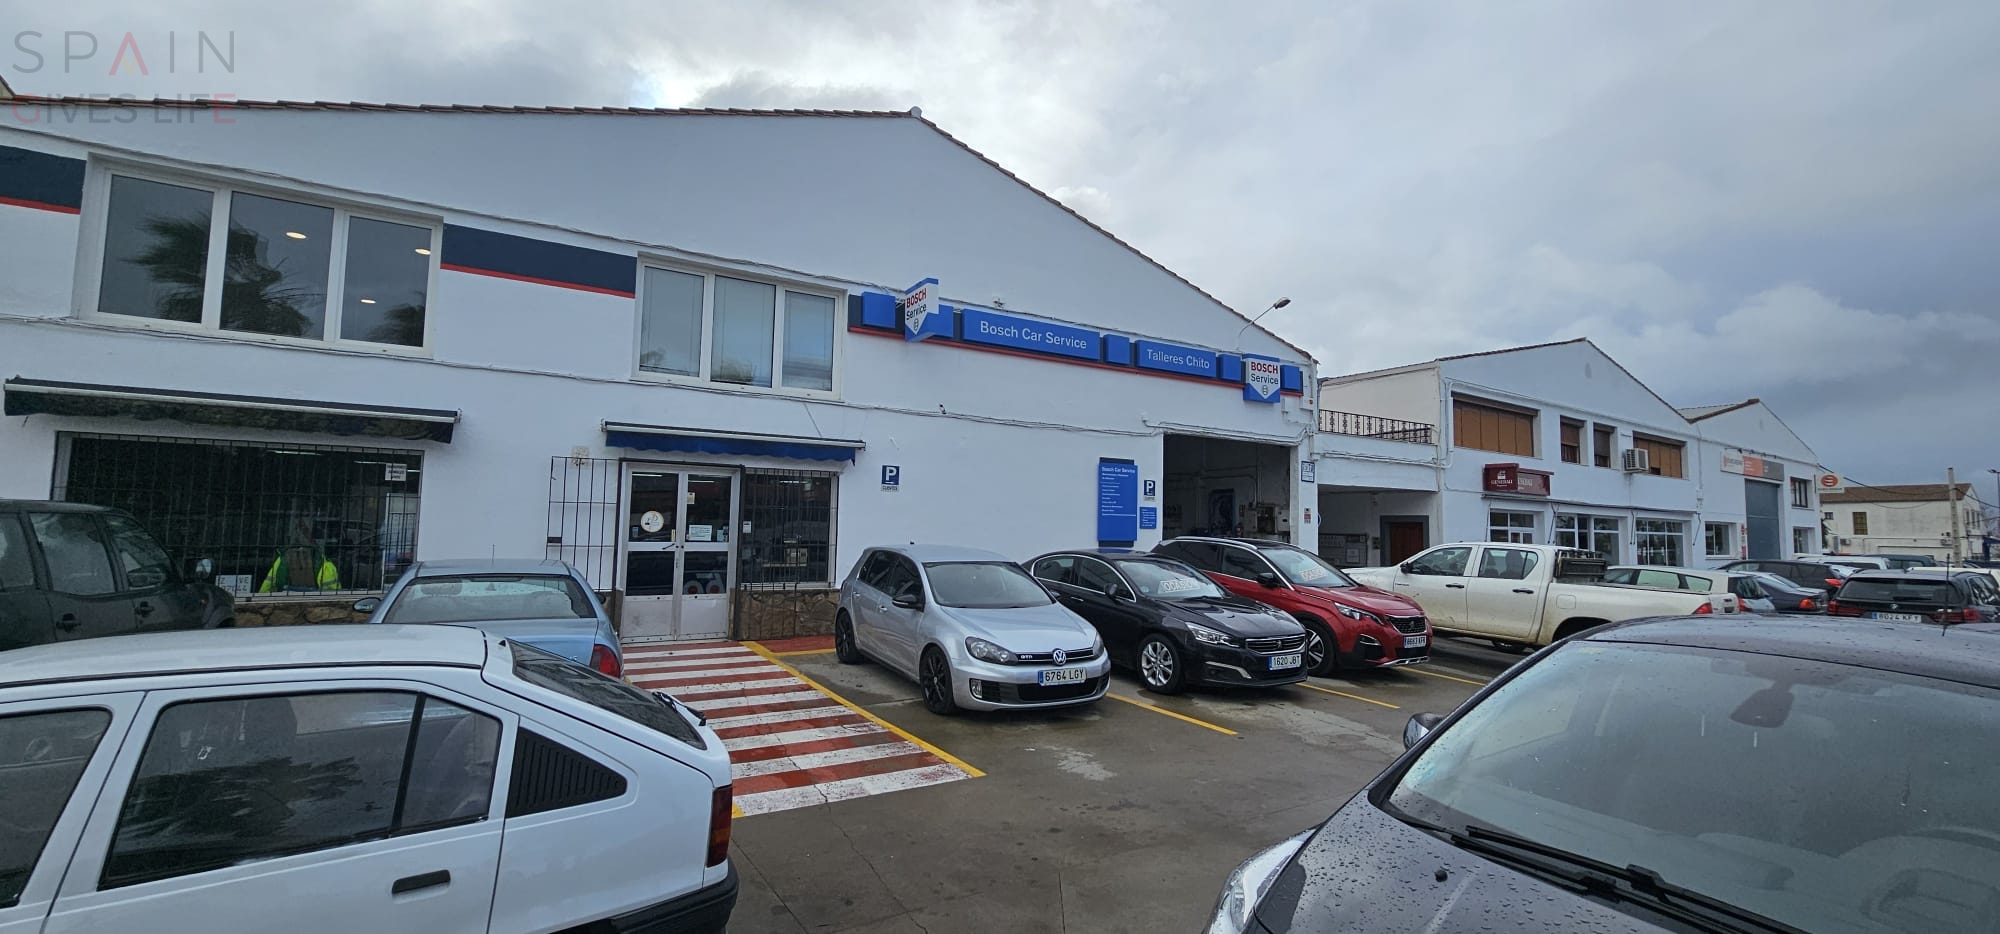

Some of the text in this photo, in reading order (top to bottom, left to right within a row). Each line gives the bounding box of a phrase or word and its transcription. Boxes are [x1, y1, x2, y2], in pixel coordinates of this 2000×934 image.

[906, 287, 927, 309] BOSCH
[906, 303, 927, 321] Service
[980, 320, 1087, 349] Bosch Car Service
[1146, 349, 1210, 369] Talleres Chito
[1250, 361, 1279, 374] BOSCH
[1250, 373, 1279, 385] Service
[885, 466, 897, 481] P
[1146, 481, 1154, 492] P
[1273, 656, 1289, 666] 1620
[1045, 669, 1084, 682] 6764 LGY
